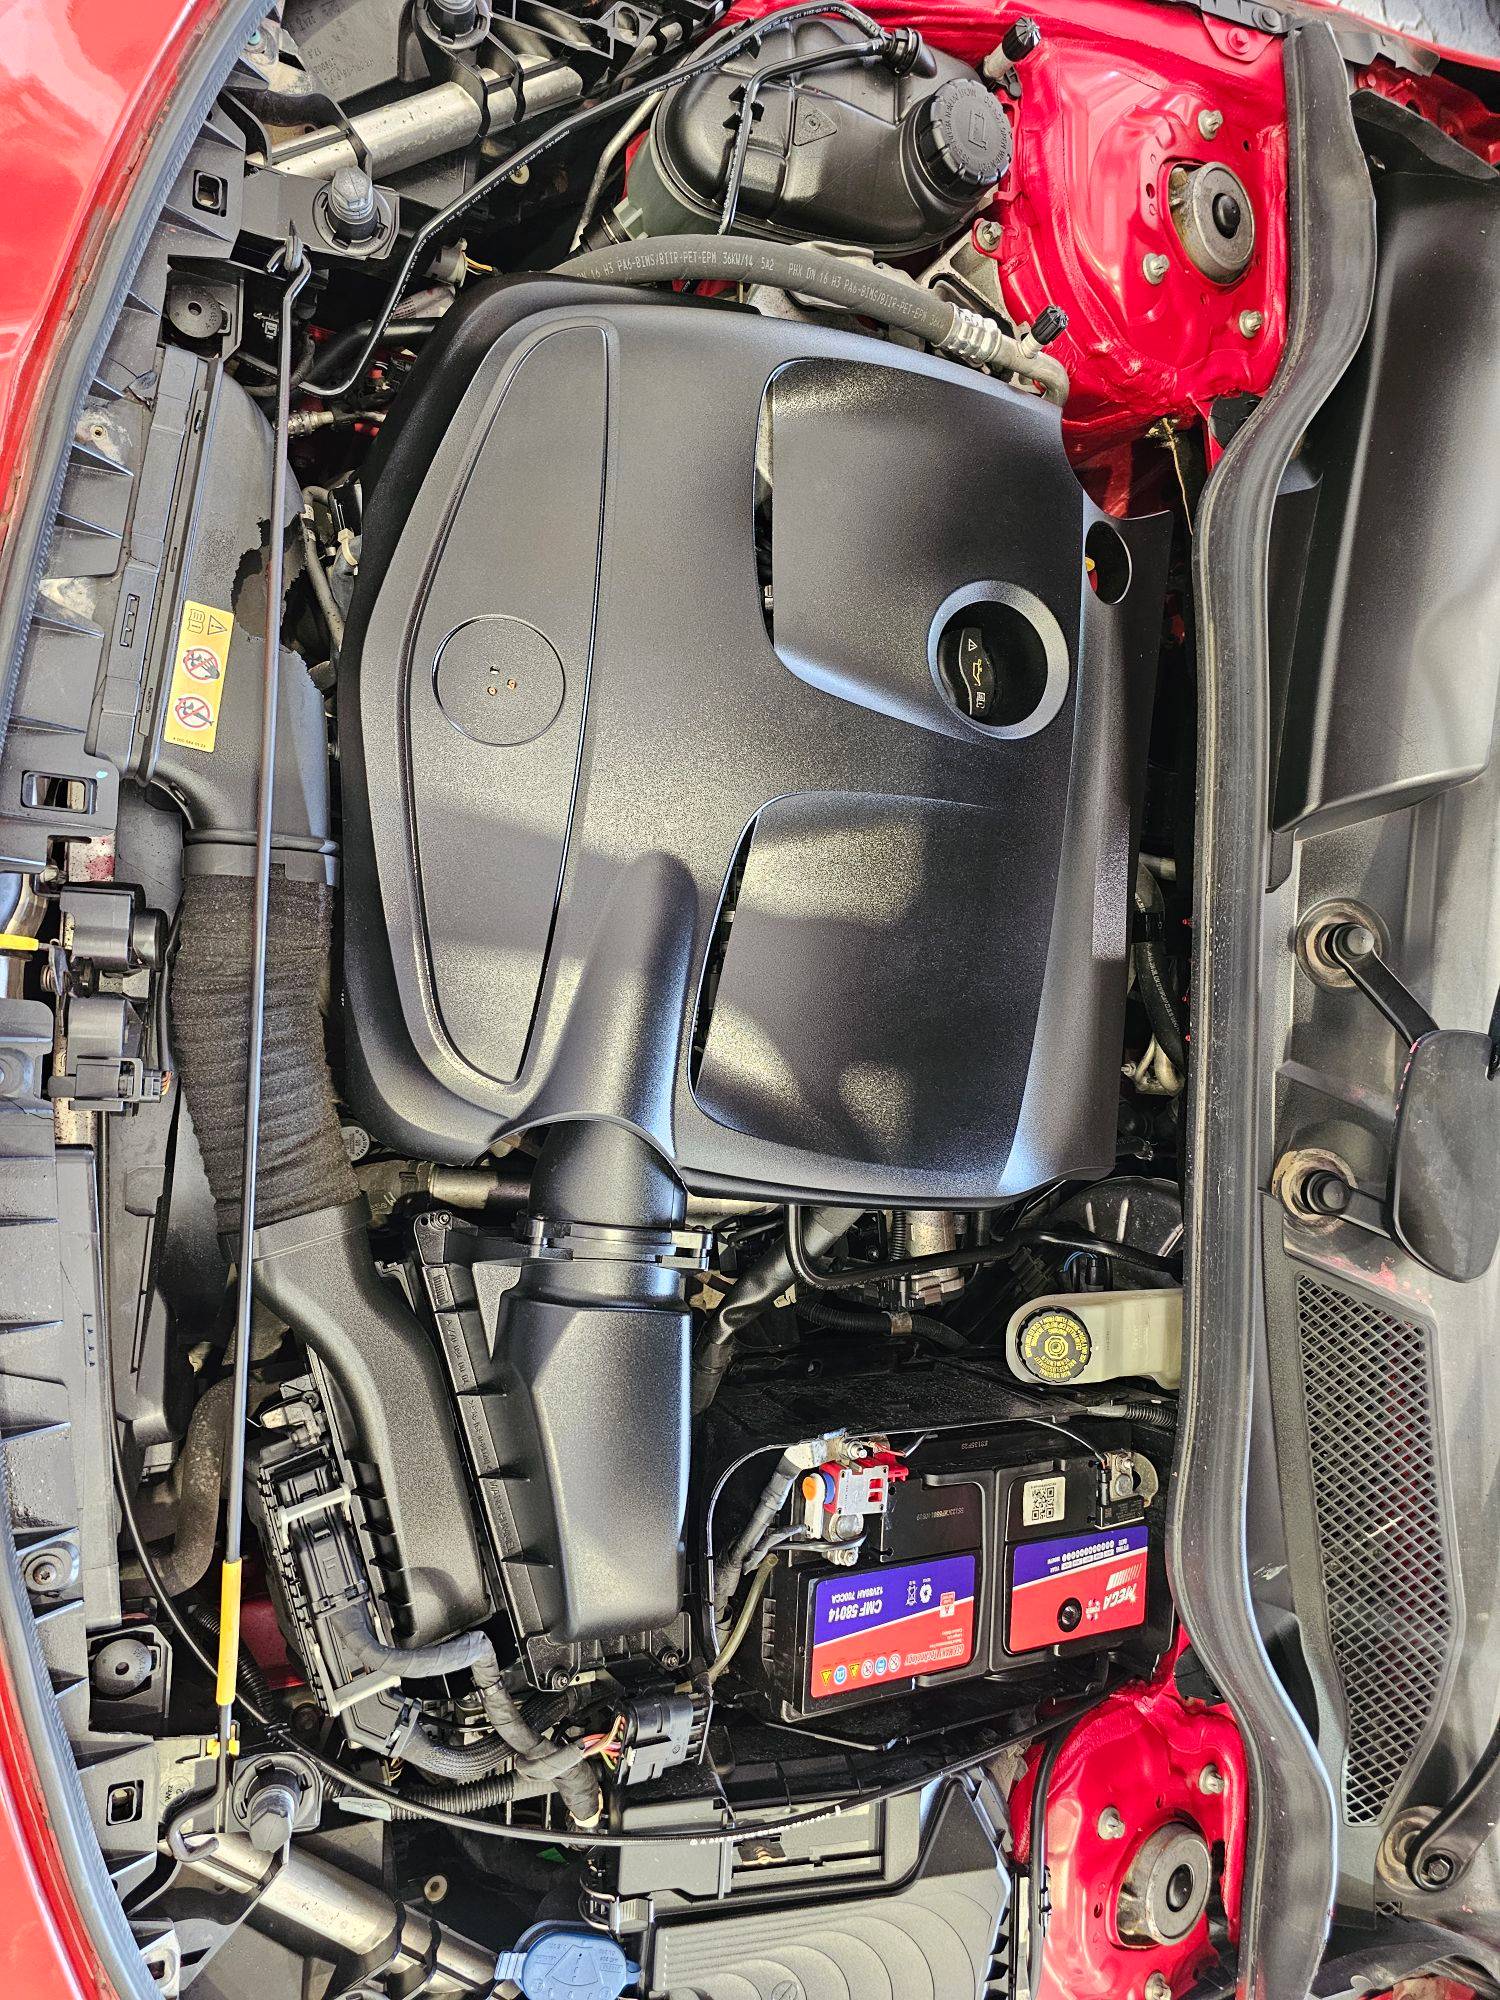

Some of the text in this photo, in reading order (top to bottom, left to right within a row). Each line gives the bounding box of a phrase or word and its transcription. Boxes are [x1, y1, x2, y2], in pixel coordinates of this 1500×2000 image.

[589, 269, 601, 282] 16
[603, 263, 614, 275] H3
[817, 270, 829, 285] 16
[830, 273, 842, 288] H3
[1104, 1583, 1138, 1611] MEGA
[828, 1599, 883, 1622] CMF 58014
